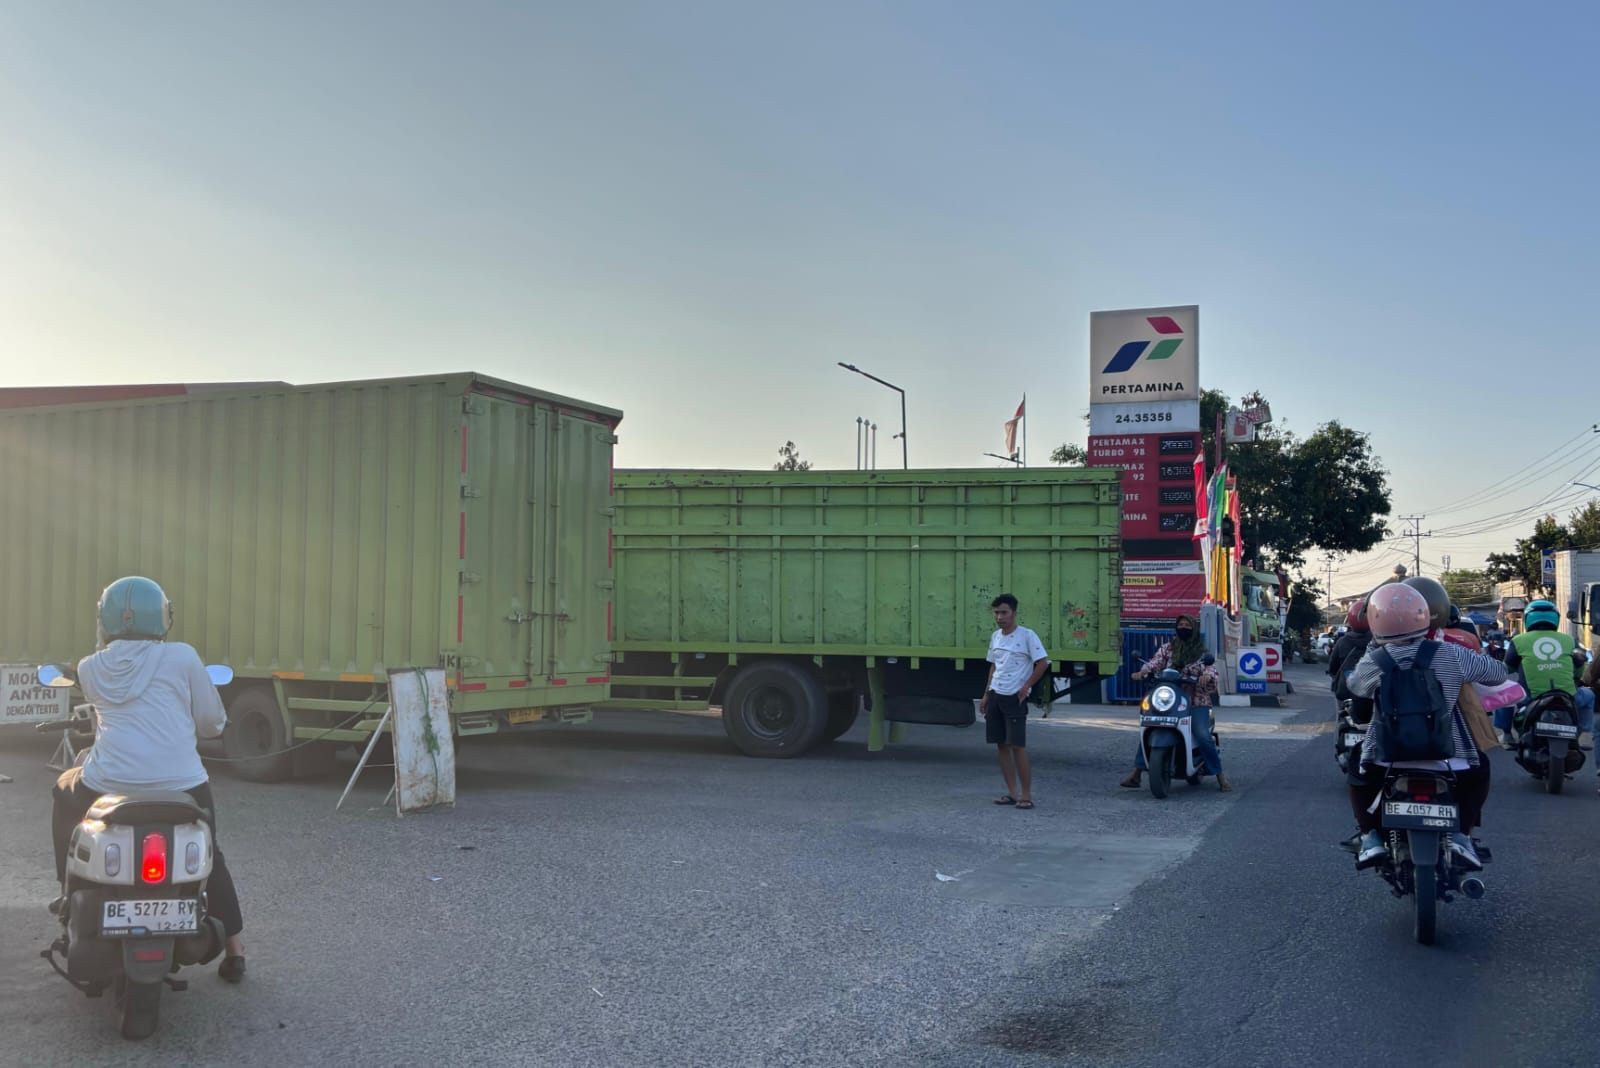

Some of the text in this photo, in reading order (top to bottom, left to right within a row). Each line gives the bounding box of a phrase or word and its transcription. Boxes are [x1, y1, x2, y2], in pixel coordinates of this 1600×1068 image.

[1102, 382, 1184, 394] PERTAMINA
[1116, 412, 1172, 423] 24.35358
[1093, 438, 1145, 447] PERTAMAX
[1093, 448, 1145, 457] TURBO 98
[1133, 473, 1145, 481] 92
[1126, 493, 1140, 501] ITE
[1122, 513, 1147, 521] MINA
[1537, 661, 1563, 671] gojek
[1240, 682, 1264, 690] MASUK
[10, 688, 57, 701] ANTRI
[1387, 803, 1453, 817] BE 4057 RH
[107, 901, 194, 918] BE 5272 RY
